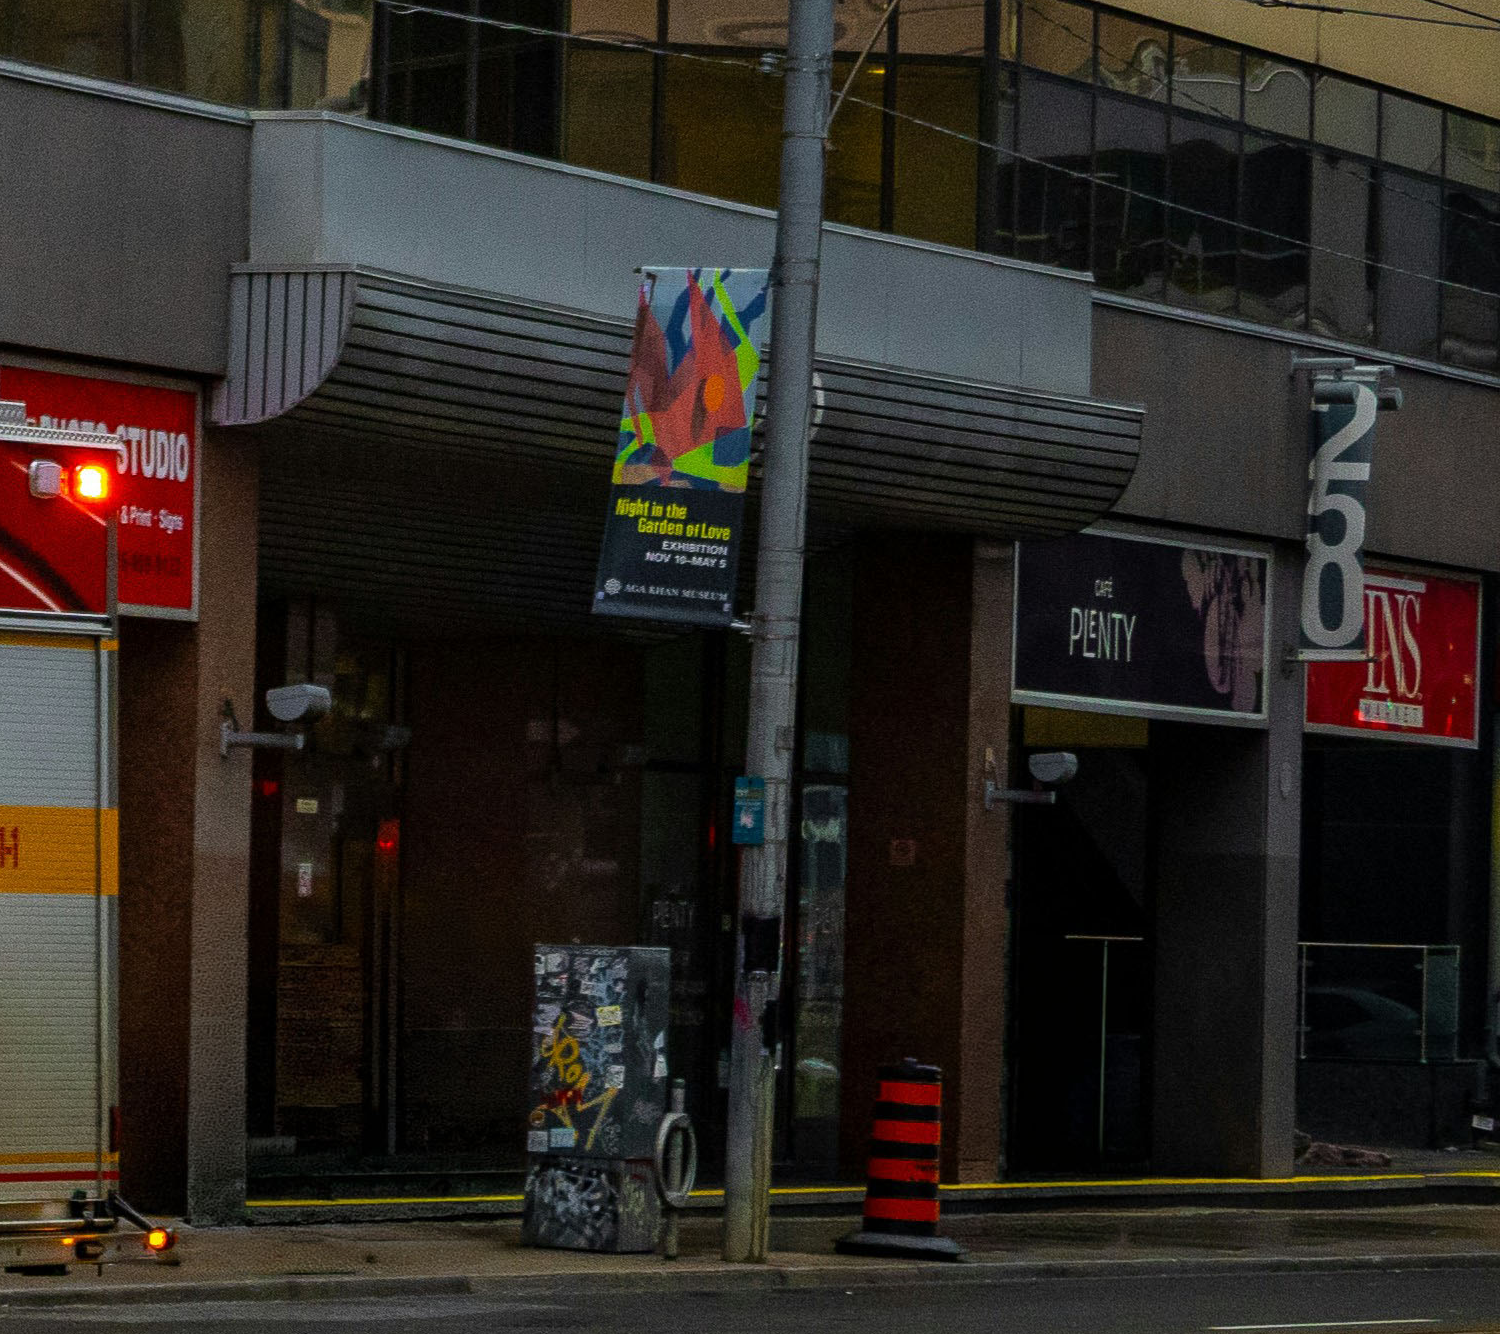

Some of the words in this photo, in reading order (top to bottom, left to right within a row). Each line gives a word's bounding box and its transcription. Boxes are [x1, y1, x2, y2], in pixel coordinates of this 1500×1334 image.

[115, 423, 190, 483] STUDIO
[615, 497, 650, 518] Night
[651, 501, 664, 517] in
[666, 503, 688, 520] the
[1301, 383, 1378, 648] 250
[637, 517, 685, 537] Garden
[685, 523, 700, 538] of
[700, 522, 731, 541] Love
[661, 539, 729, 556] EXHIBITION
[644, 551, 671, 564] NOV
[719, 558, 727, 569] 5
[624, 583, 646, 595] AGA
[648, 585, 680, 597] KHAN
[681, 588, 729, 602] MUSEUM
[1068, 606, 1137, 663] PLENTY
